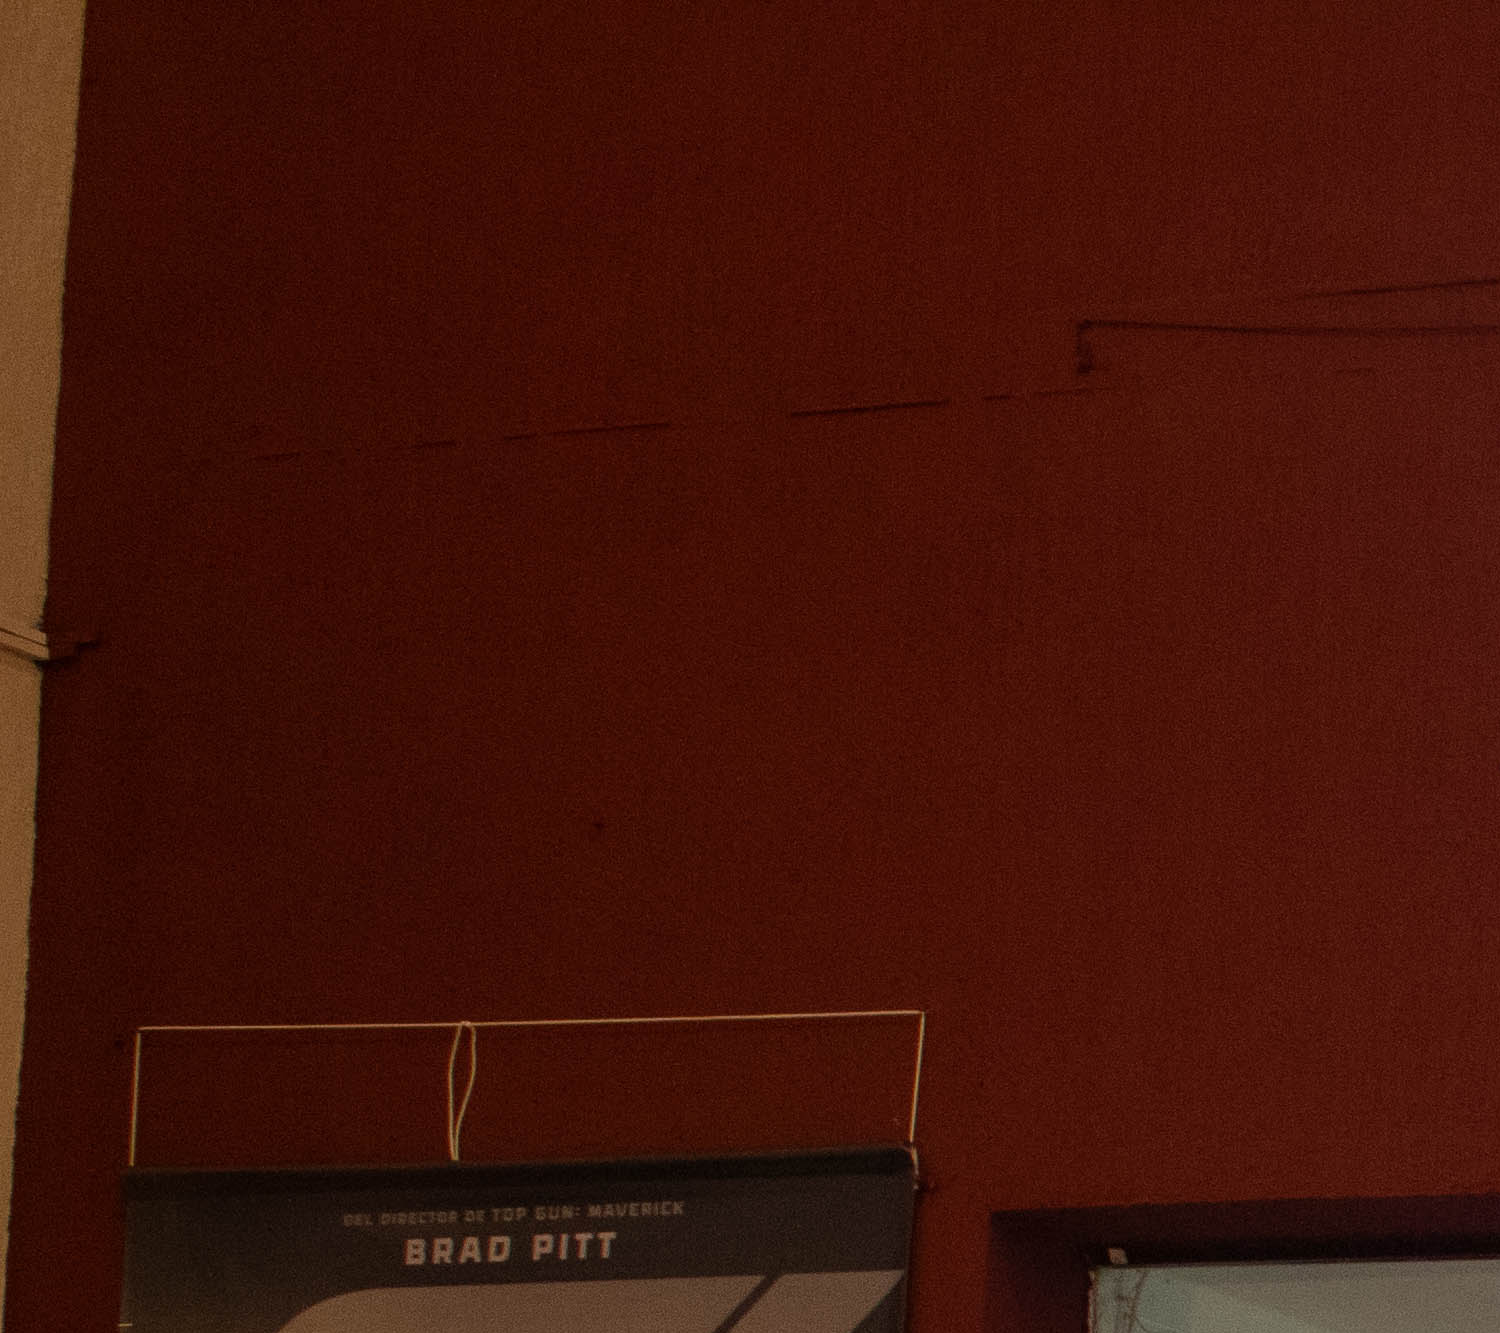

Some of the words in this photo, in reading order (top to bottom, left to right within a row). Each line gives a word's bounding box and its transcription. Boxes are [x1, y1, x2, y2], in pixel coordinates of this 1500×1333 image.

[493, 1207, 528, 1223] TOP
[588, 1201, 686, 1218] MAVERICK
[404, 1235, 511, 1266] BRAD
[532, 1231, 618, 1262] PITT
